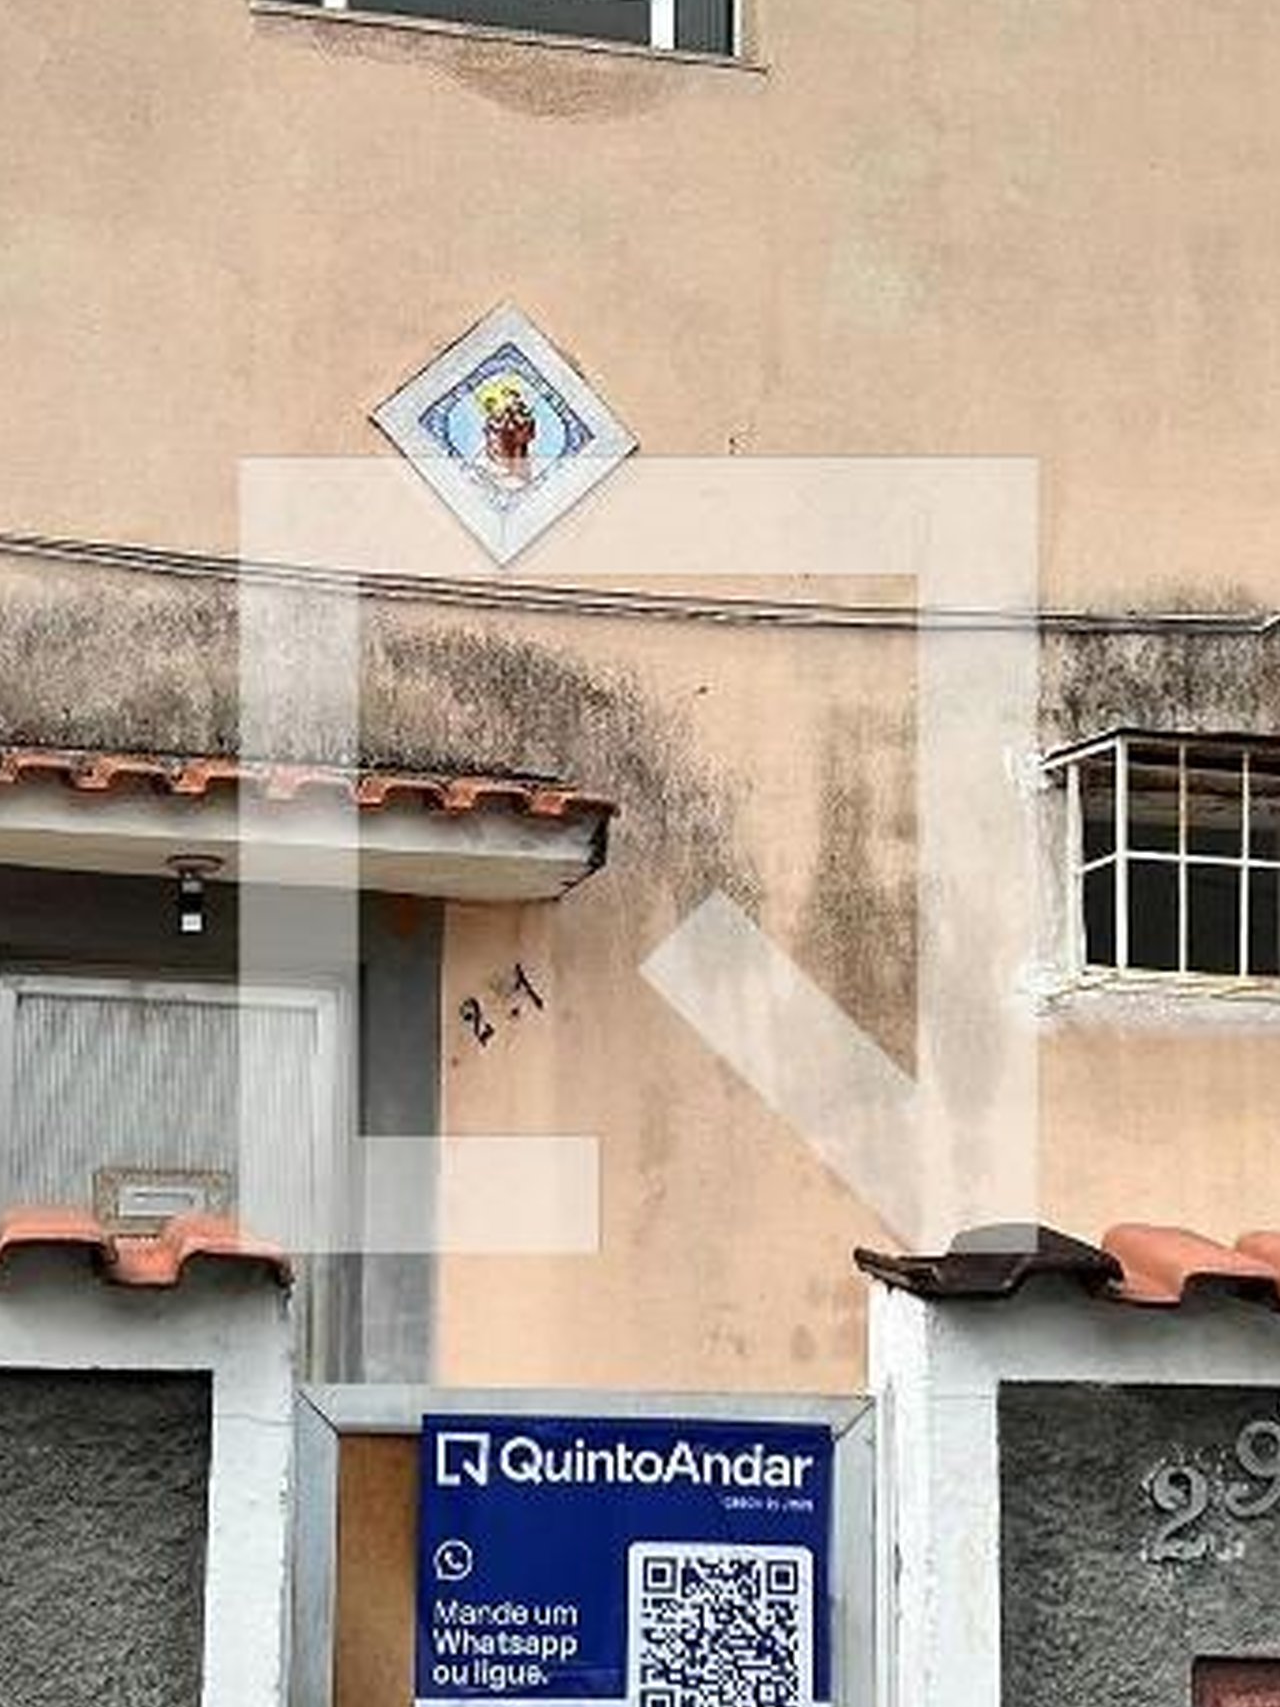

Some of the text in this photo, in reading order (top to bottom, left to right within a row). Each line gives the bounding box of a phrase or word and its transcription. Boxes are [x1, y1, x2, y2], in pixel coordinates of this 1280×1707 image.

[500, 1436, 813, 1489] QuintoAndar
[434, 1600, 578, 1626] Mande um
[433, 1628, 578, 1662] Whatsapp
[432, 1658, 549, 1692] ou ligue.
